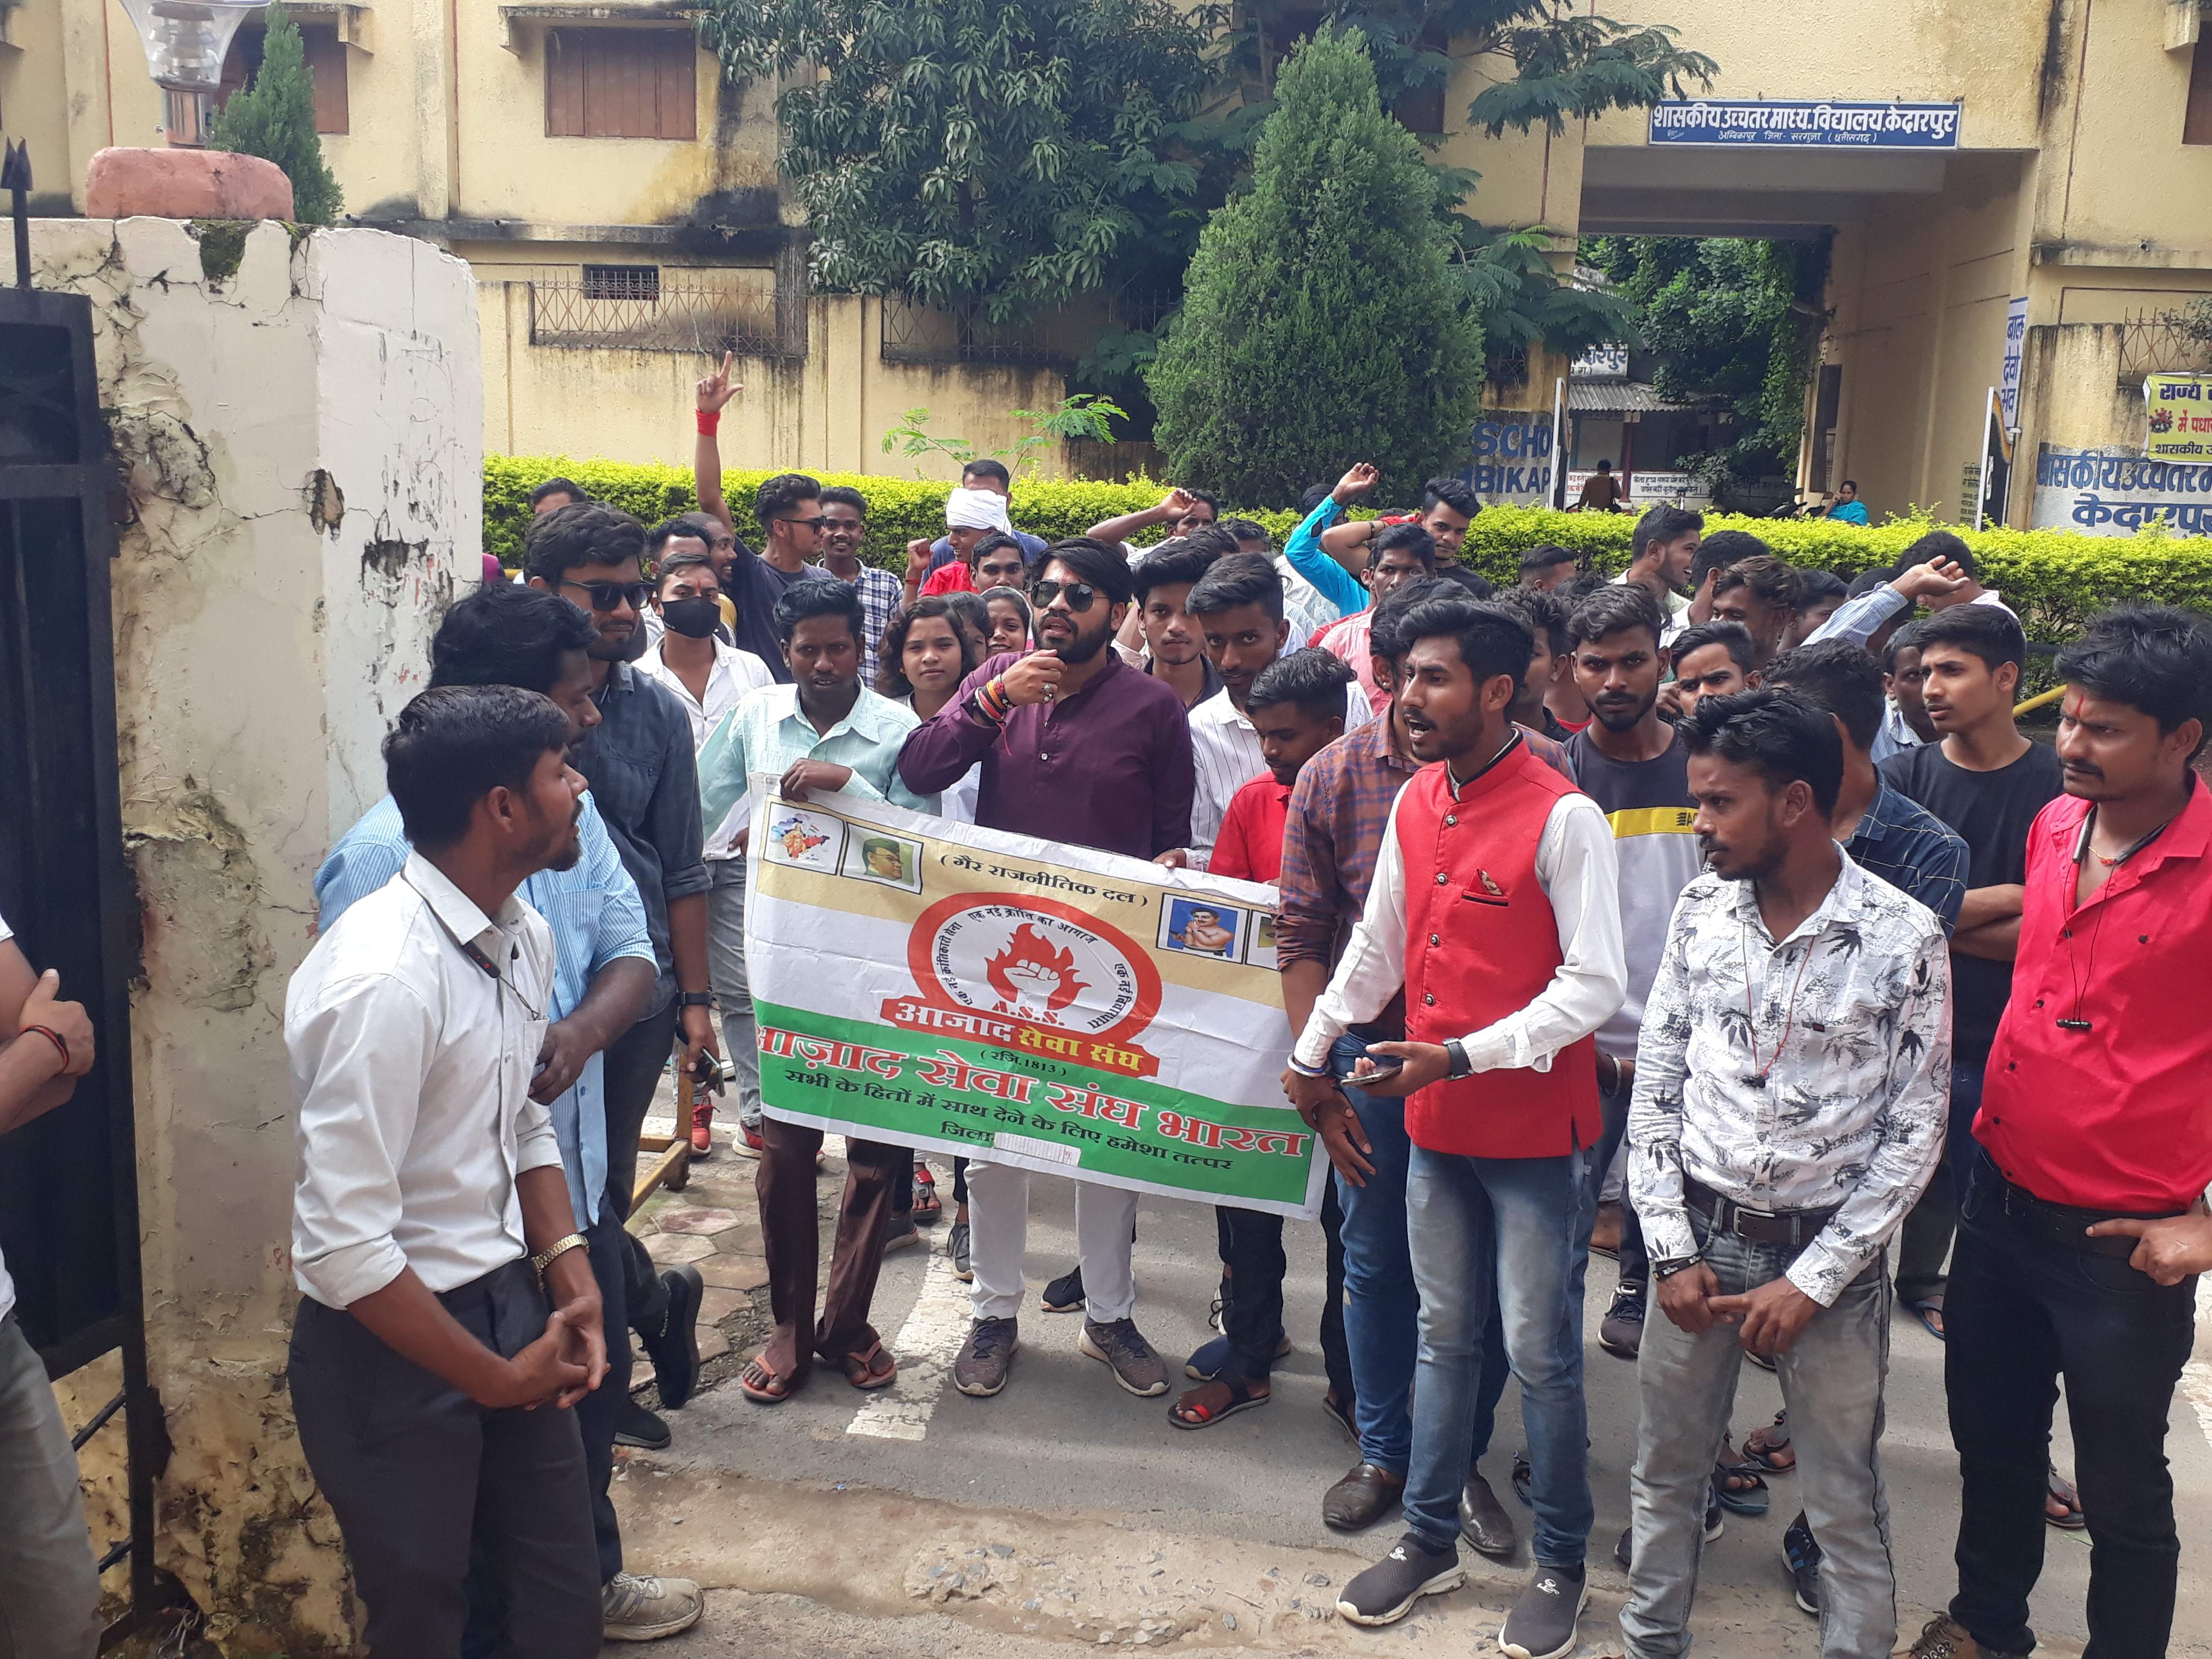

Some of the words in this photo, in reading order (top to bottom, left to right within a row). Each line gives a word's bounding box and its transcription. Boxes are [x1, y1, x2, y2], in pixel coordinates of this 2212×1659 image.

[1653, 102, 1723, 128] शासकीय
[1885, 105, 1957, 140] केदारपुर
[2177, 409, 2188, 433] में
[1471, 421, 1553, 458] SCHO
[2155, 441, 2203, 454] शासकीय
[988, 864, 1097, 895] राजनीतिक
[943, 921, 963, 937] सेना
[1037, 915, 1056, 927] का
[991, 1000, 1066, 1027] A.S.S.
[894, 1002, 1016, 1043] आजाद
[1018, 1025, 1083, 1058] सेवा
[1089, 1042, 1144, 1072] संघ
[916, 1050, 1038, 1104] सेवा
[1044, 1081, 1149, 1130] संघ
[1157, 1109, 1311, 1156] भारत
[784, 1070, 830, 1089] सभी
[835, 1077, 860, 1093] के
[863, 1082, 910, 1104] हितों
[916, 1092, 937, 1108] में
[941, 1098, 989, 1117] साथ
[993, 1105, 1027, 1125] देने
[1031, 1114, 1056, 1130] के
[1059, 1121, 1102, 1144] लिए
[1106, 1134, 1168, 1159] हमेशा
[1172, 1150, 1234, 1169] तत्पर
